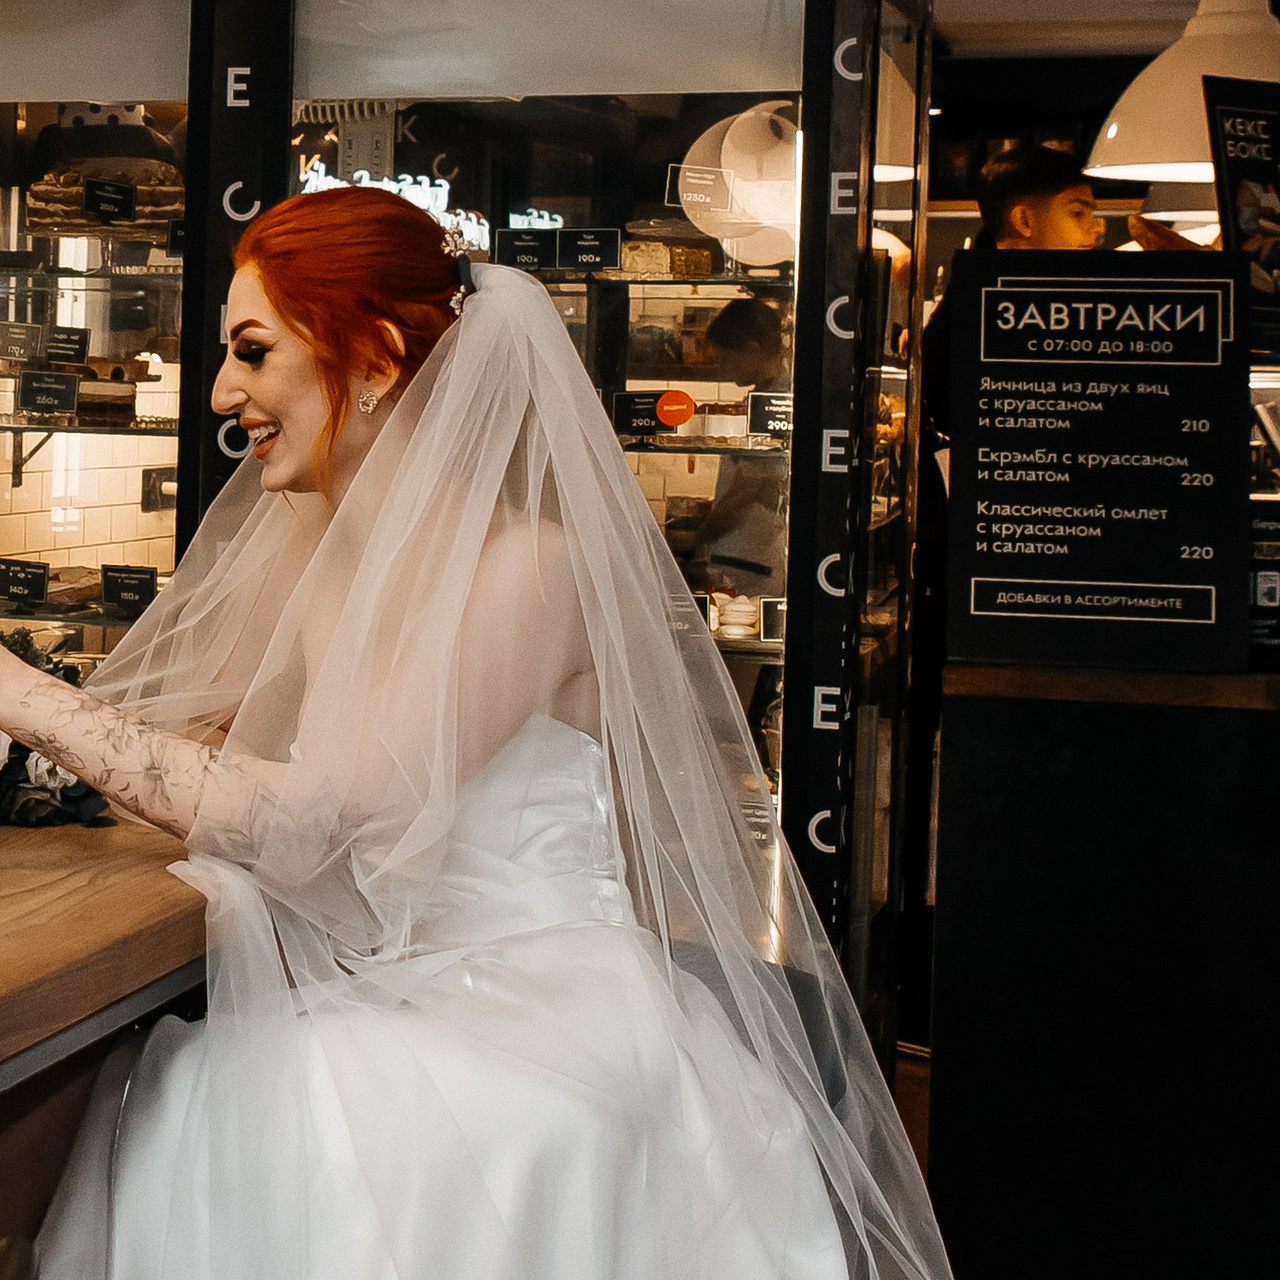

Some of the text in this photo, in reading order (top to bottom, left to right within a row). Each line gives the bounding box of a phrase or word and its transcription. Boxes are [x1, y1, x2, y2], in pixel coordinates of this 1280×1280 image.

[996, 302, 1205, 332] ЗАВТРАКИ
[1043, 340, 1093, 352] 07:00
[1129, 341, 1174, 353] 18:00
[979, 377, 1170, 397] Яичница из двух яиц
[978, 398, 1103, 413] с круассаном
[978, 416, 1210, 432] и салатом 210
[977, 448, 1189, 468] Скрэмбл с круассаном
[977, 470, 1214, 486] и салатом 220
[976, 501, 1168, 520] Классический омлет
[976, 523, 1102, 538] с круассаном
[976, 542, 1214, 559] и салатом 220
[996, 592, 1183, 609] ДОБАВКИ В АССОРТИМЕНТЕ
